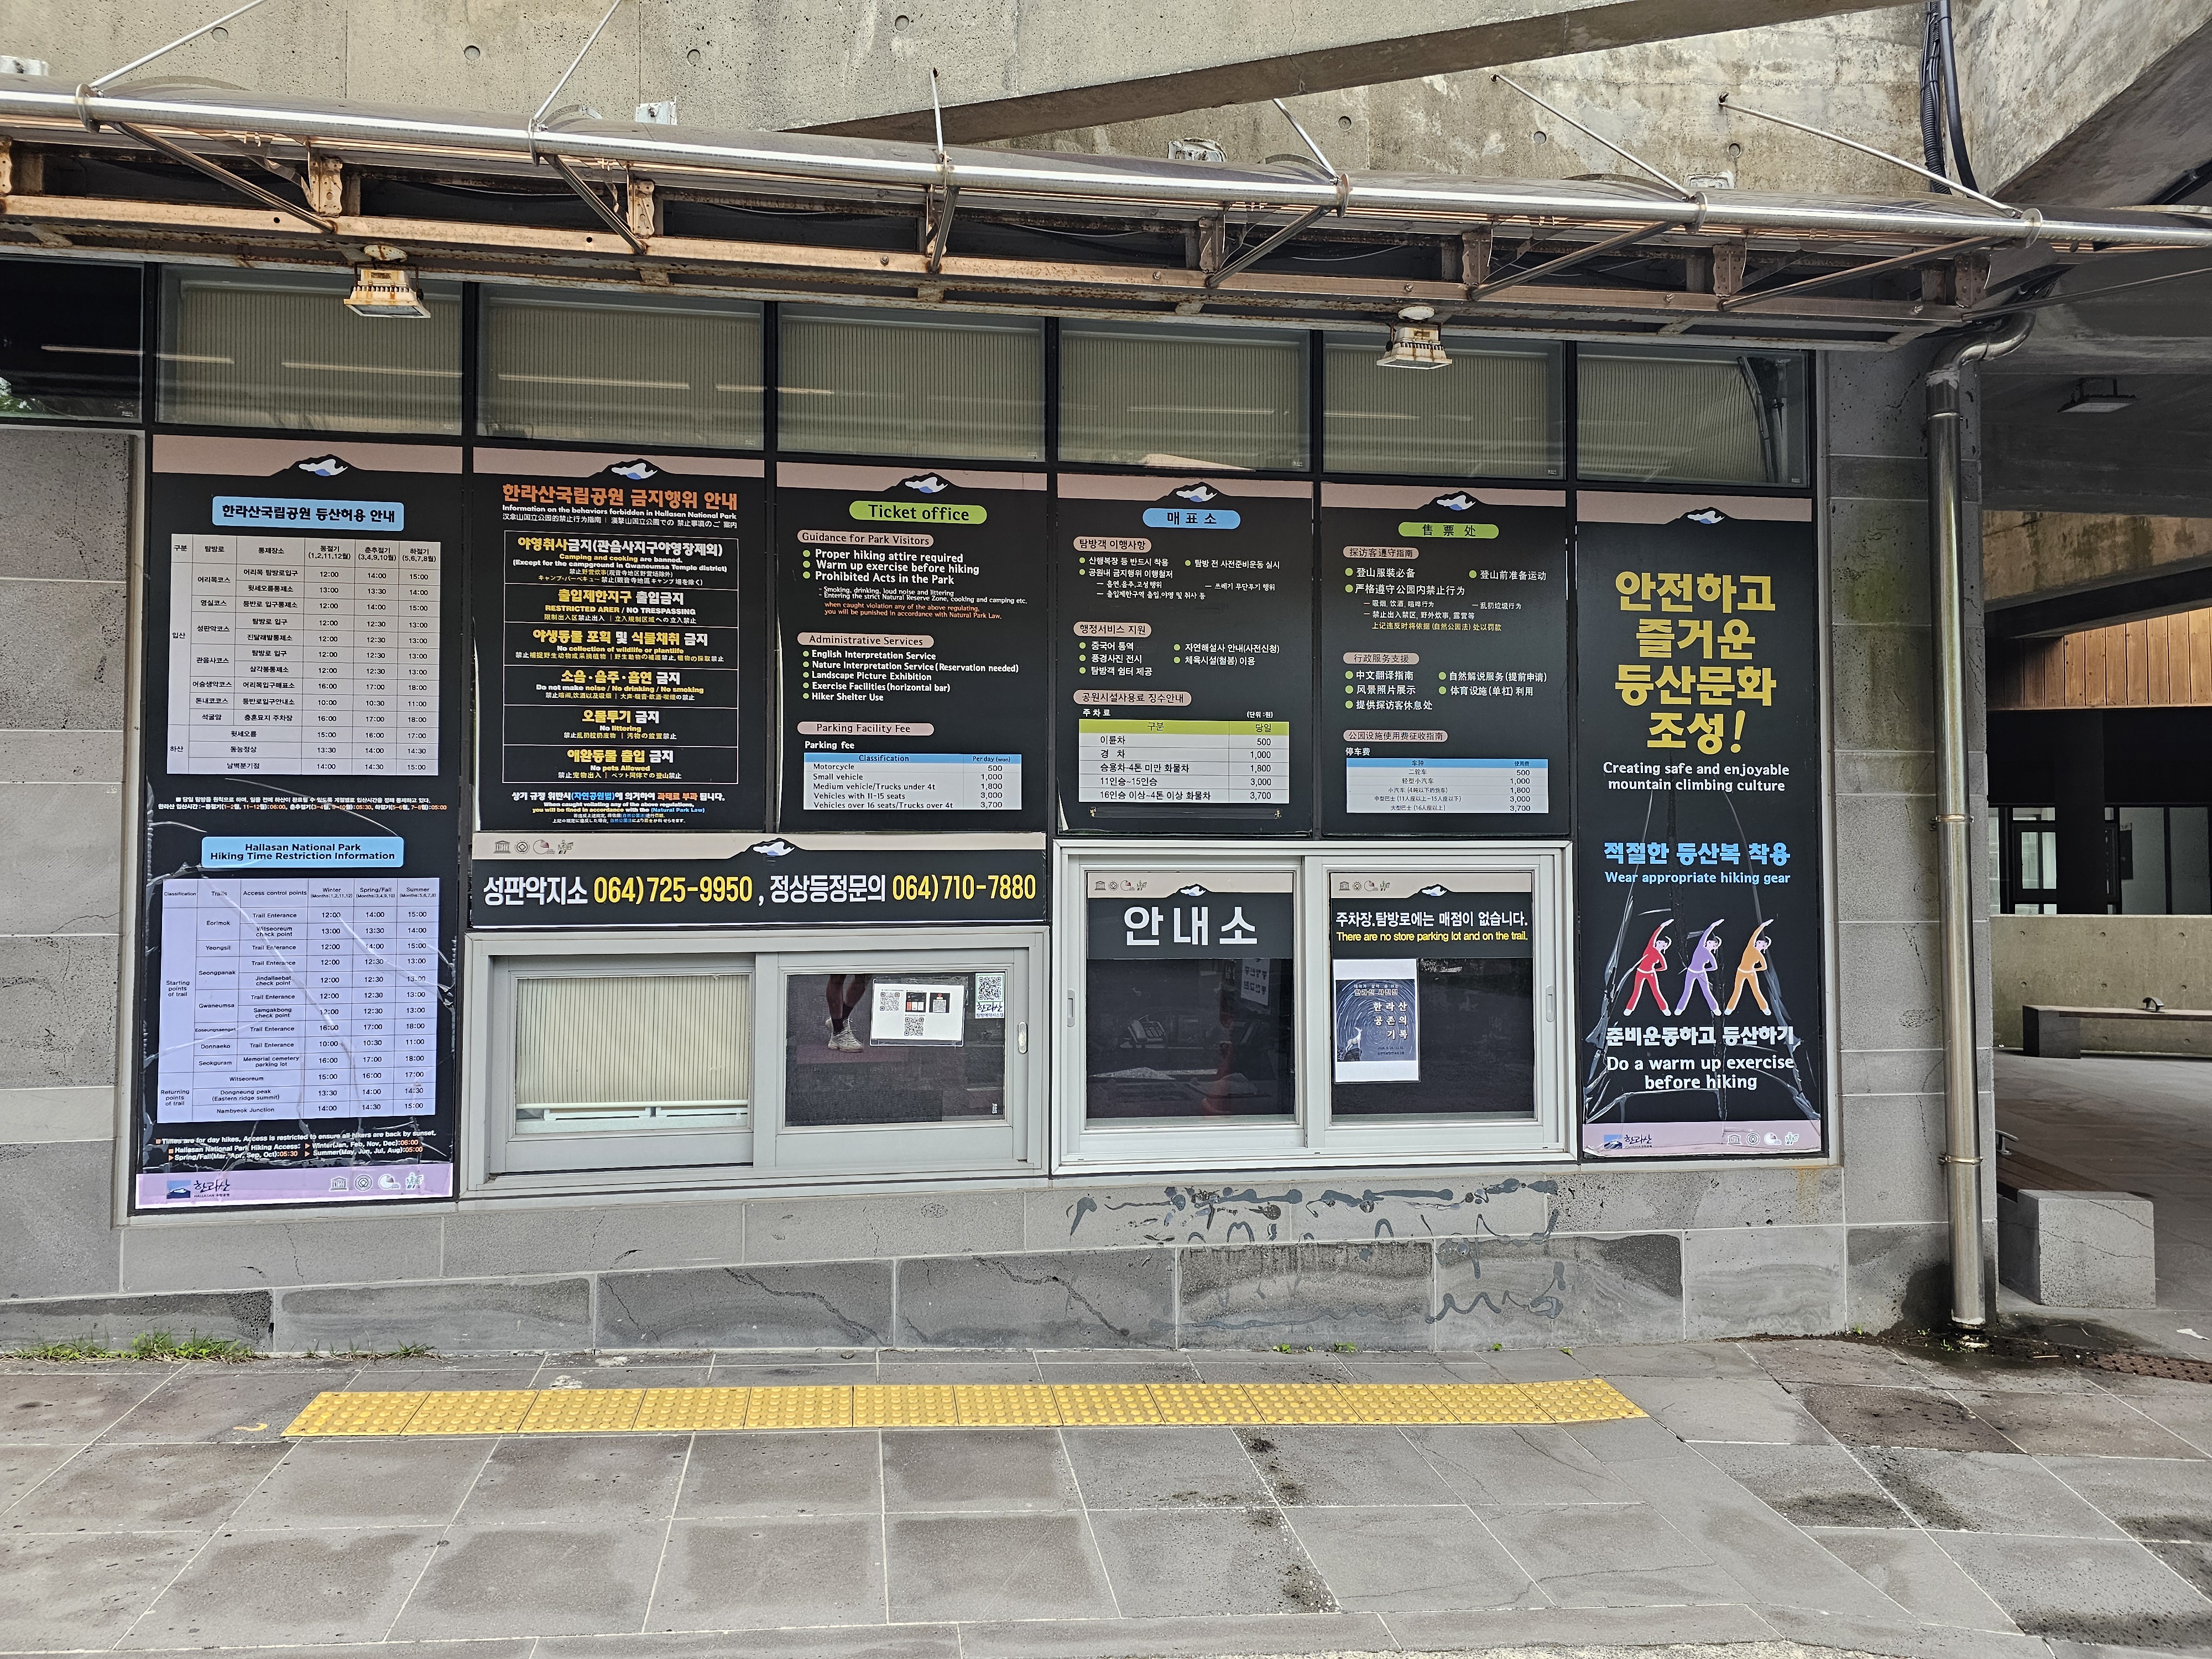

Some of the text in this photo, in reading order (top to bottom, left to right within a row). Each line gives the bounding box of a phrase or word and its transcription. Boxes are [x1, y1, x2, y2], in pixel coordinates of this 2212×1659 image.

[502, 483, 737, 510] 한라산국립공원 금지행위 안내
[222, 504, 395, 523] 한라산국립공원 등산허용 안내
[502, 504, 546, 512] Information
[571, 507, 608, 515] behaviors
[609, 508, 645, 516] forbidden
[868, 504, 969, 521] Ticket office
[802, 532, 930, 545] Guidance for Park Visitors
[1079, 539, 1146, 551] 탐방객 이행사항
[518, 537, 723, 557] 야영취사금지(관음사지구야영장제외)
[559, 553, 592, 562] Camping
[815, 548, 963, 564] Proper hiking attire required
[816, 559, 979, 576] Warm up exercise before hiking
[557, 588, 684, 606] 출입제한지구 출입금지
[1615, 571, 1776, 614] 안전하고
[640, 607, 696, 615] TRESPASSING
[1079, 624, 1146, 635] 행정서비스 지원
[809, 635, 923, 646] Administrative Services
[1636, 618, 1756, 660] 즐거운
[1615, 664, 1777, 706] 등산문화
[1082, 692, 1183, 703] 공원시설사용료 징수안내
[582, 709, 659, 724] 오물투기 금지
[817, 723, 911, 734] Parking Facility Fee
[1647, 709, 1746, 755] 조성!
[1256, 738, 1271, 746] 500
[1603, 761, 1790, 777] Creating safe and enjoyable
[1608, 778, 1785, 792] mountain climbing culture
[1250, 791, 1271, 801] 3,700
[211, 852, 244, 861] Hiking
[247, 852, 273, 860] Time
[275, 852, 332, 860] Restriction
[292, 843, 335, 854] National
[1604, 842, 1791, 867] 적절한 등산복 착용
[1604, 872, 1791, 885] Wear appropriate hiking gear
[483, 874, 1036, 906] 성판악지소 064)725-9950 정상등정문의 064)710-7880
[1439, 911, 1474, 927] 매점이
[1478, 911, 1528, 926] 없습니다.
[1336, 931, 1362, 941] There
[1393, 932, 1415, 941] store
[1417, 931, 1449, 942] parking
[1451, 931, 1462, 941] lot
[1463, 931, 1480, 941] and
[1495, 931, 1510, 941] the
[1605, 1026, 1794, 1047] 준비운동하고 등산하기
[1606, 1054, 1797, 1072] Do a warm up exercise
[1644, 1074, 1757, 1093] before hiking
